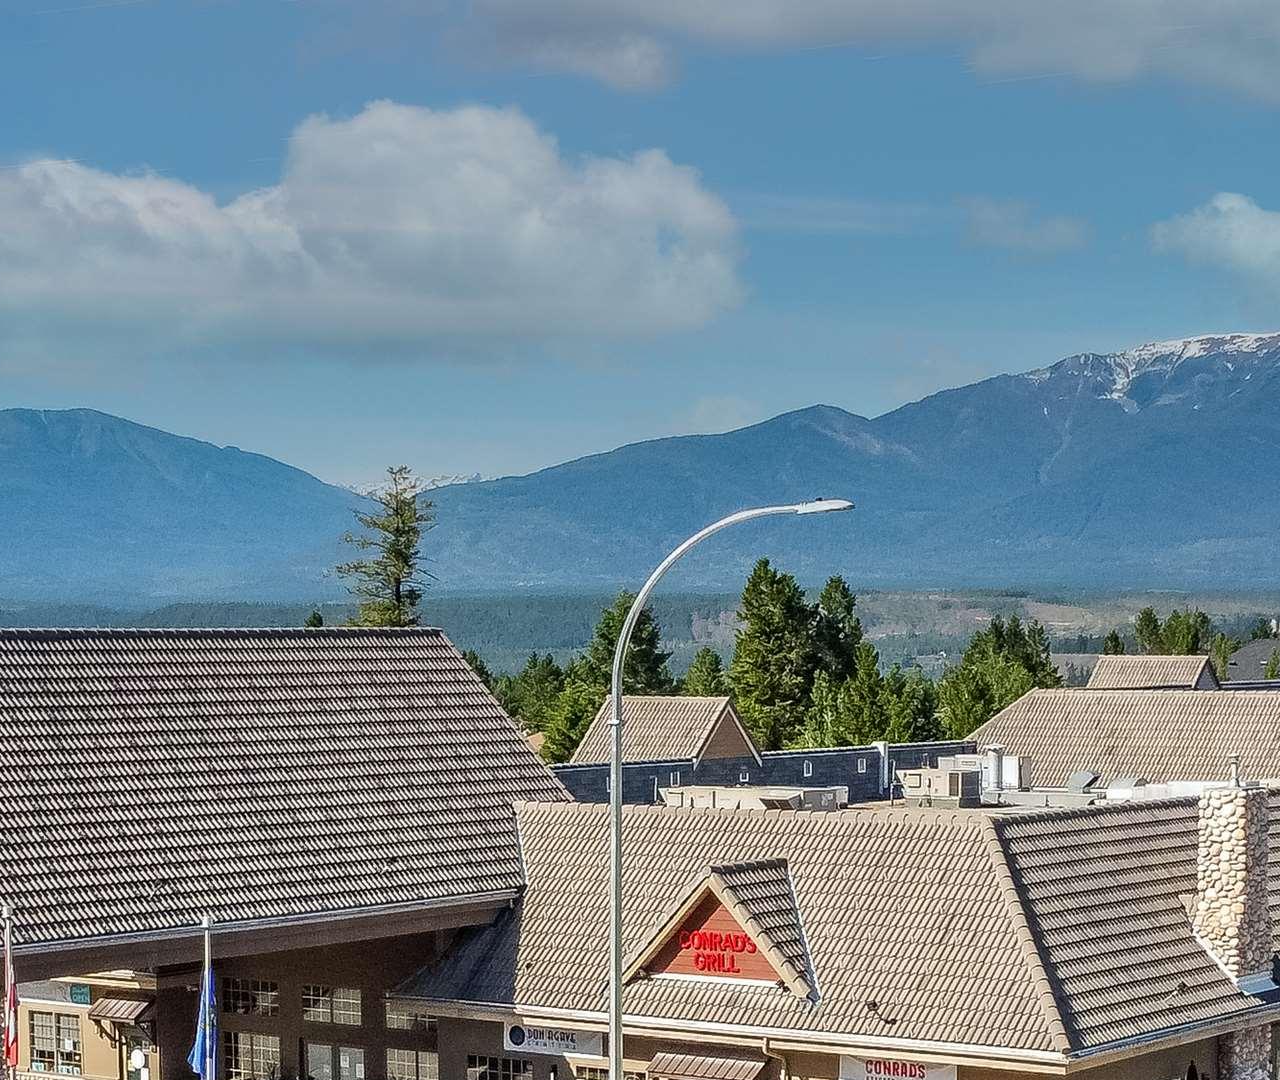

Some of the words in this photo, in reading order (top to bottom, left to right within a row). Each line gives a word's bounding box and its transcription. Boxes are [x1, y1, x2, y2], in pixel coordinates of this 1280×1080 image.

[694, 953, 740, 973] GRILL
[528, 1029, 545, 1040] DON
[548, 1030, 577, 1044] AGAVE
[865, 1060, 926, 1079] CONRAD'S
